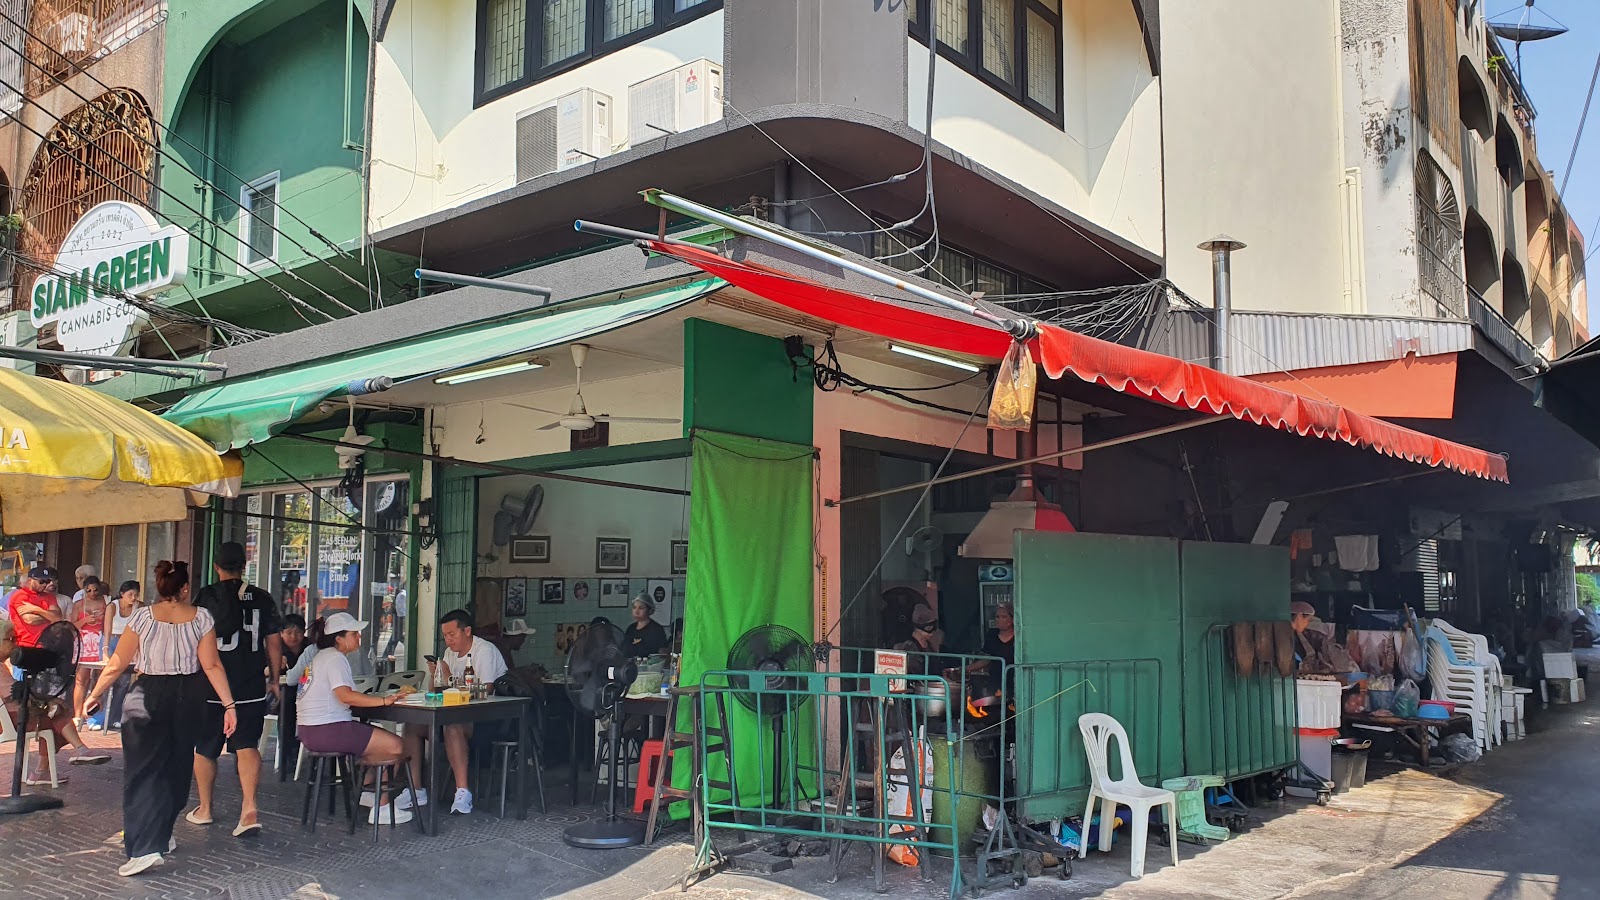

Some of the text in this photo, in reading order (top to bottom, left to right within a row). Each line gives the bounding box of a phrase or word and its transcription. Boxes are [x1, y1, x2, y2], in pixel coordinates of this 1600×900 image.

[101, 229, 123, 241] 2022
[33, 236, 172, 320] SIAM GREEN
[61, 306, 112, 335] CANNABIS
[326, 536, 333, 545] AS
[334, 535, 349, 545] SEEN
[329, 569, 349, 582] Times
[885, 657, 902, 665] PHOTOS
